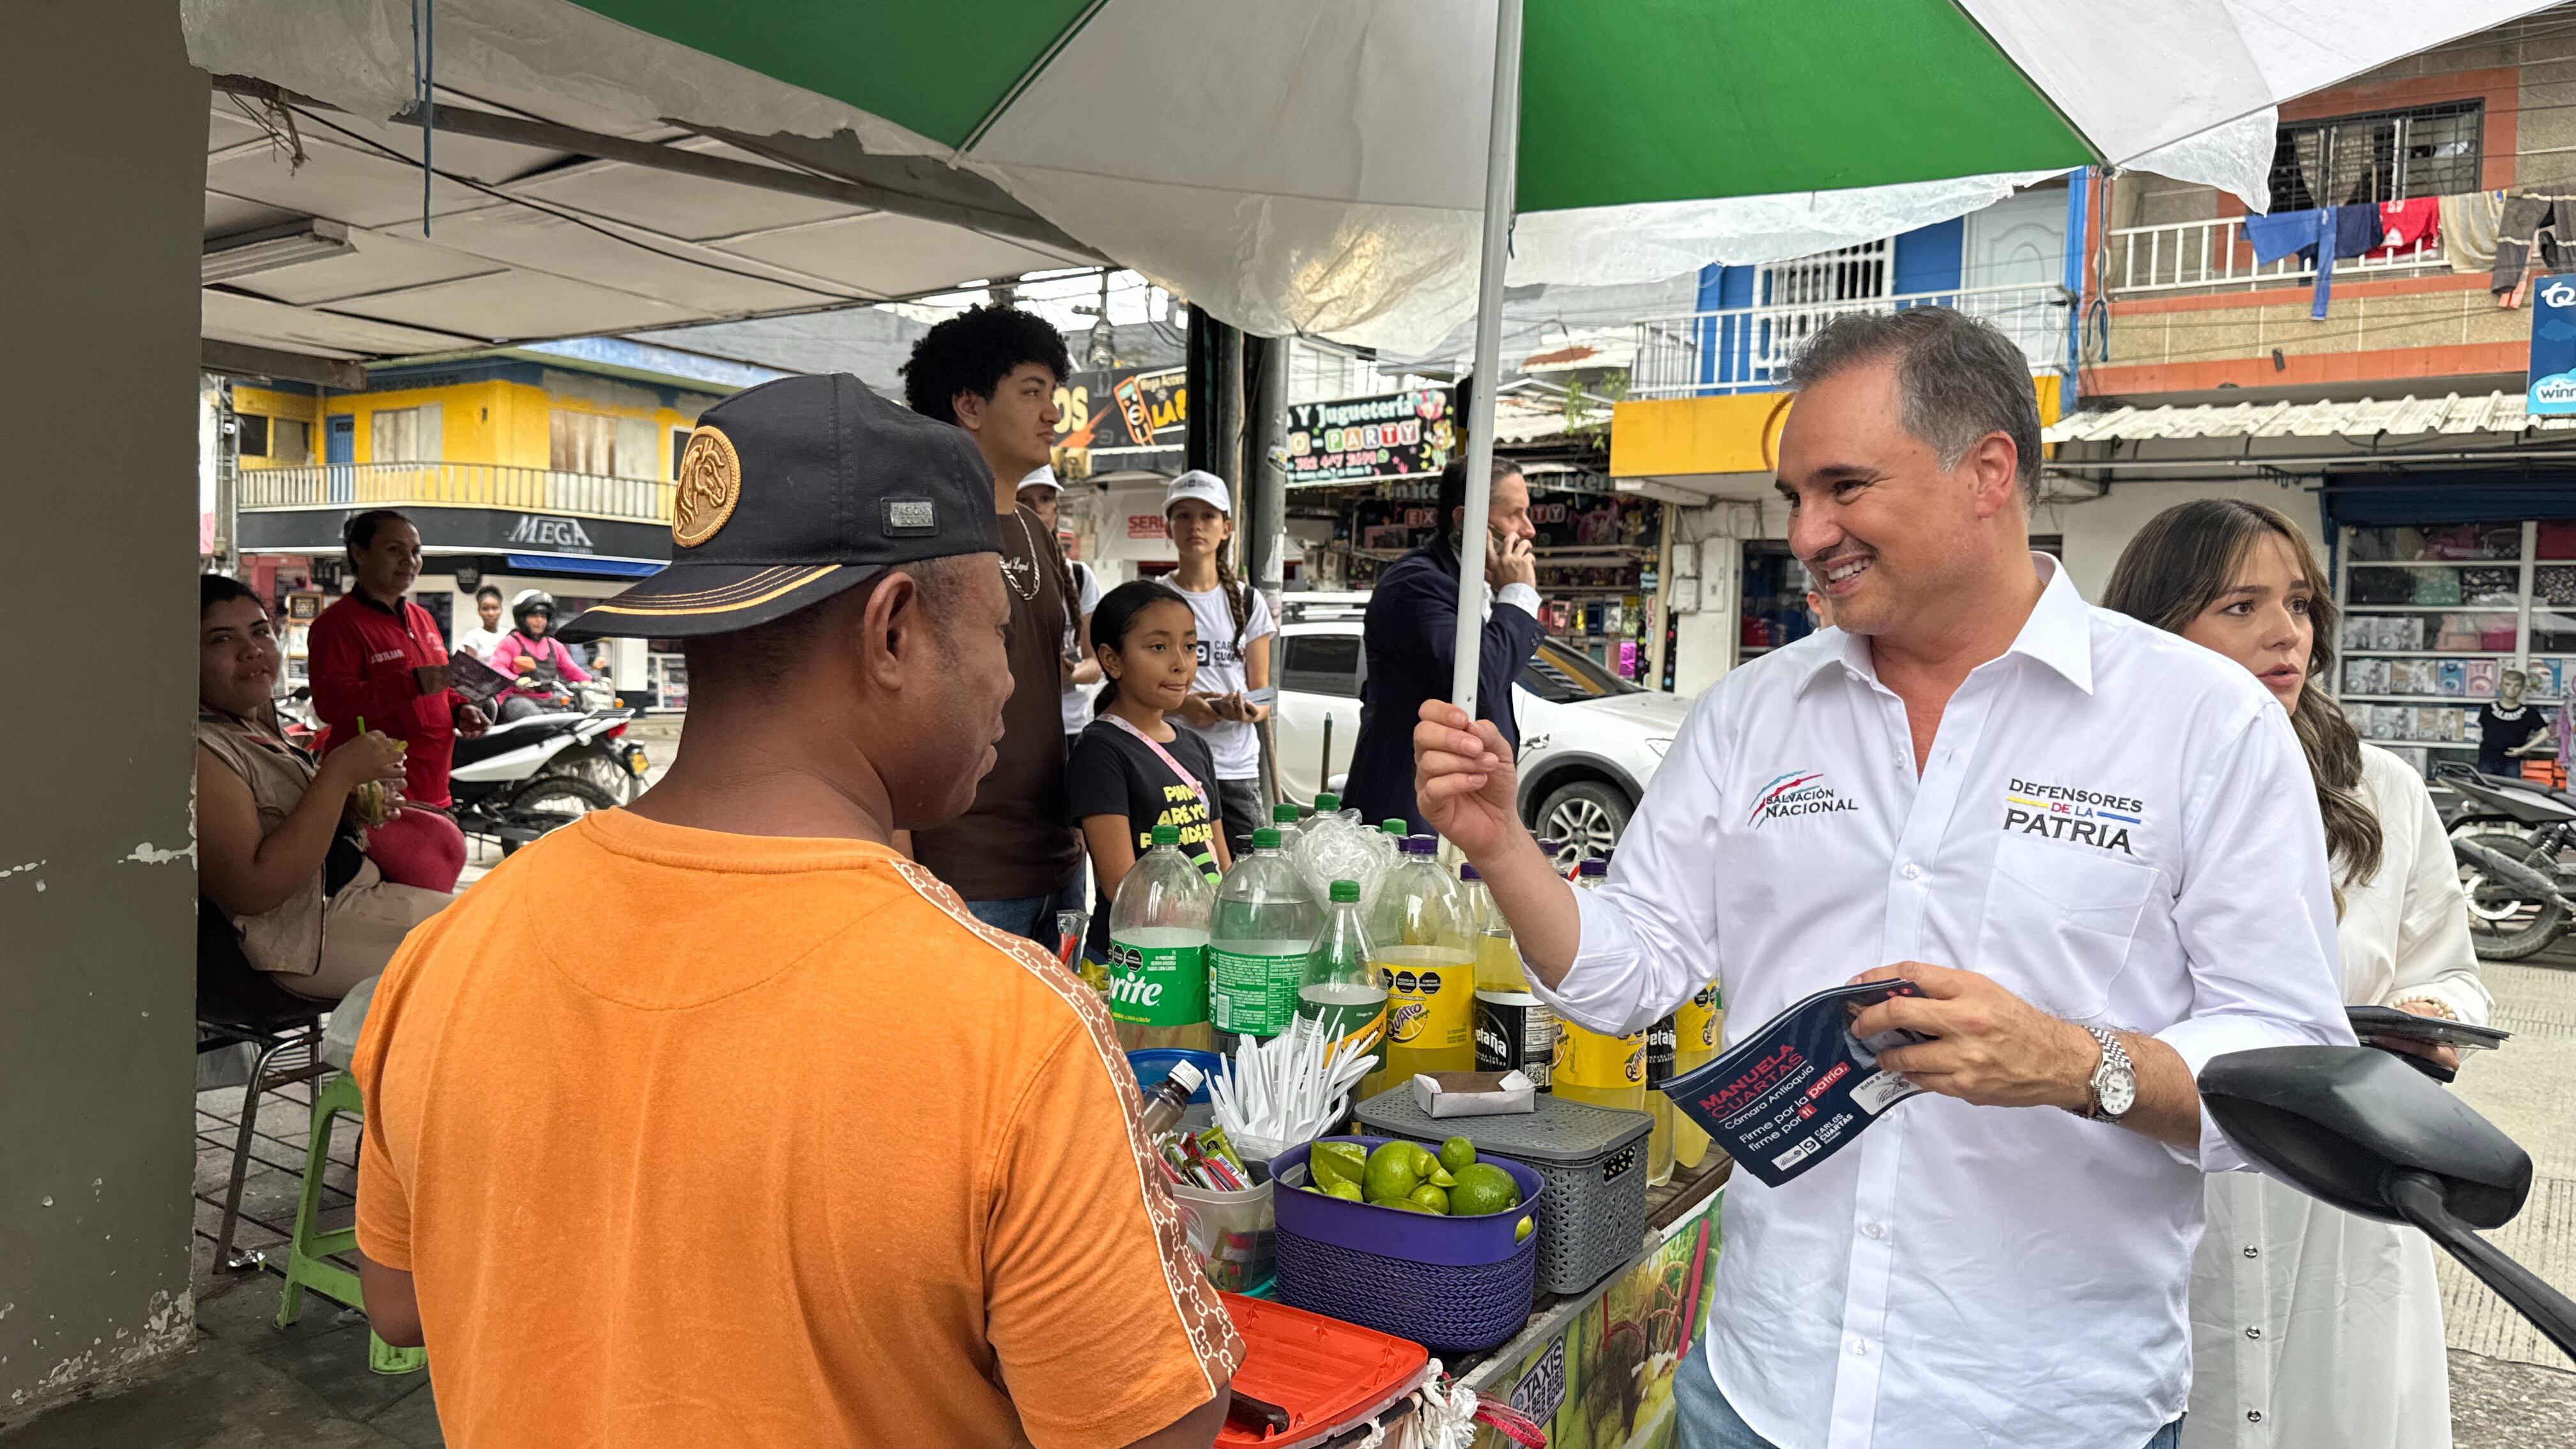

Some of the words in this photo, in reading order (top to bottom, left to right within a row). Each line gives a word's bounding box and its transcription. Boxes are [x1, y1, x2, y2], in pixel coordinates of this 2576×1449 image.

[2540, 384, 2576, 399] winn
[1054, 386, 1088, 434] OS
[1296, 404, 1310, 427] Y
[1315, 395, 1416, 428] Juguetería
[1328, 422, 1418, 451] PARTY
[508, 514, 594, 546] MEGA
[1215, 640, 1232, 651] CAR
[1765, 799, 1859, 818] NACIONAL
[1766, 788, 1834, 805] SALVACIÓN
[2009, 778, 2143, 813] DEFENSORES
[2051, 802, 2072, 815] DE
[2074, 806, 2094, 818] LA
[1157, 804, 1193, 825] ARE
[1189, 803, 1207, 820] YO
[2003, 808, 2133, 855] PATRIA
[1110, 971, 1163, 1007] rite
[1475, 1027, 1506, 1058] etaña
[1699, 1044, 1795, 1111] MANUELA
[1712, 1053, 1803, 1118] CUARTAS
[1725, 1102, 1768, 1130] Cámara
[1768, 1065, 1815, 1104] Antioquia
[1739, 1122, 1774, 1144] Firme
[1774, 1105, 1795, 1124] por
[1793, 1096, 1809, 1107] la
[1748, 1131, 1781, 1151] firme
[1781, 1115, 1803, 1134] por
[1802, 1107, 1813, 1117] ti
[1814, 1113, 1843, 1137] CARLOS
[1819, 1113, 1854, 1141] CUARTAS
[1804, 1140, 1816, 1151] 9
[1823, 1131, 1841, 1144] Senado
[1524, 1345, 1563, 1403] TAXIS
